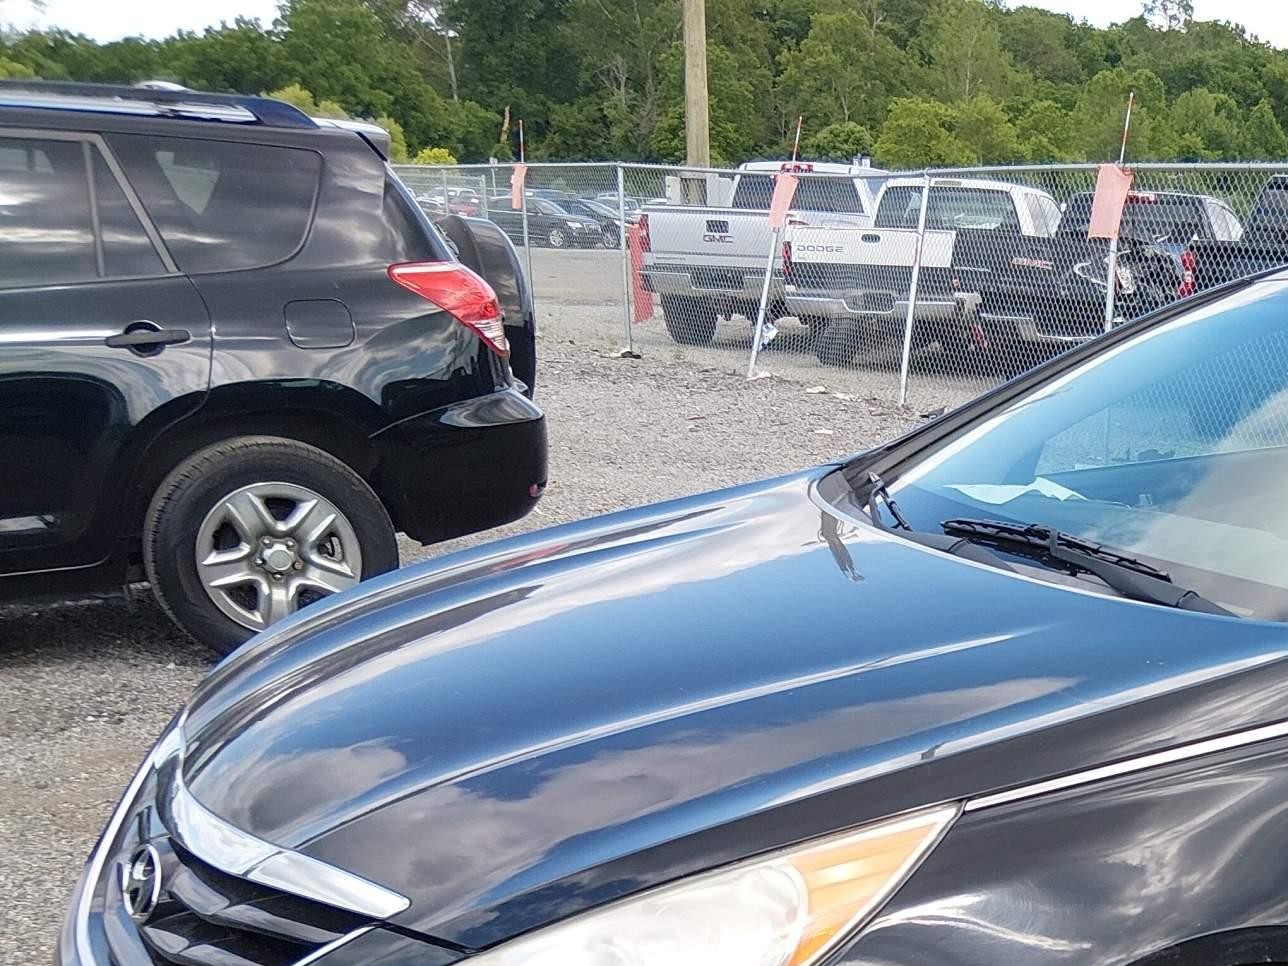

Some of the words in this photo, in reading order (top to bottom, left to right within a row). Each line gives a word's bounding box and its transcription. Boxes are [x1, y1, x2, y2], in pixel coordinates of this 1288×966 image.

[703, 234, 733, 244] GMC
[797, 244, 844, 253] DODGE
[1012, 257, 1053, 270] GMC
